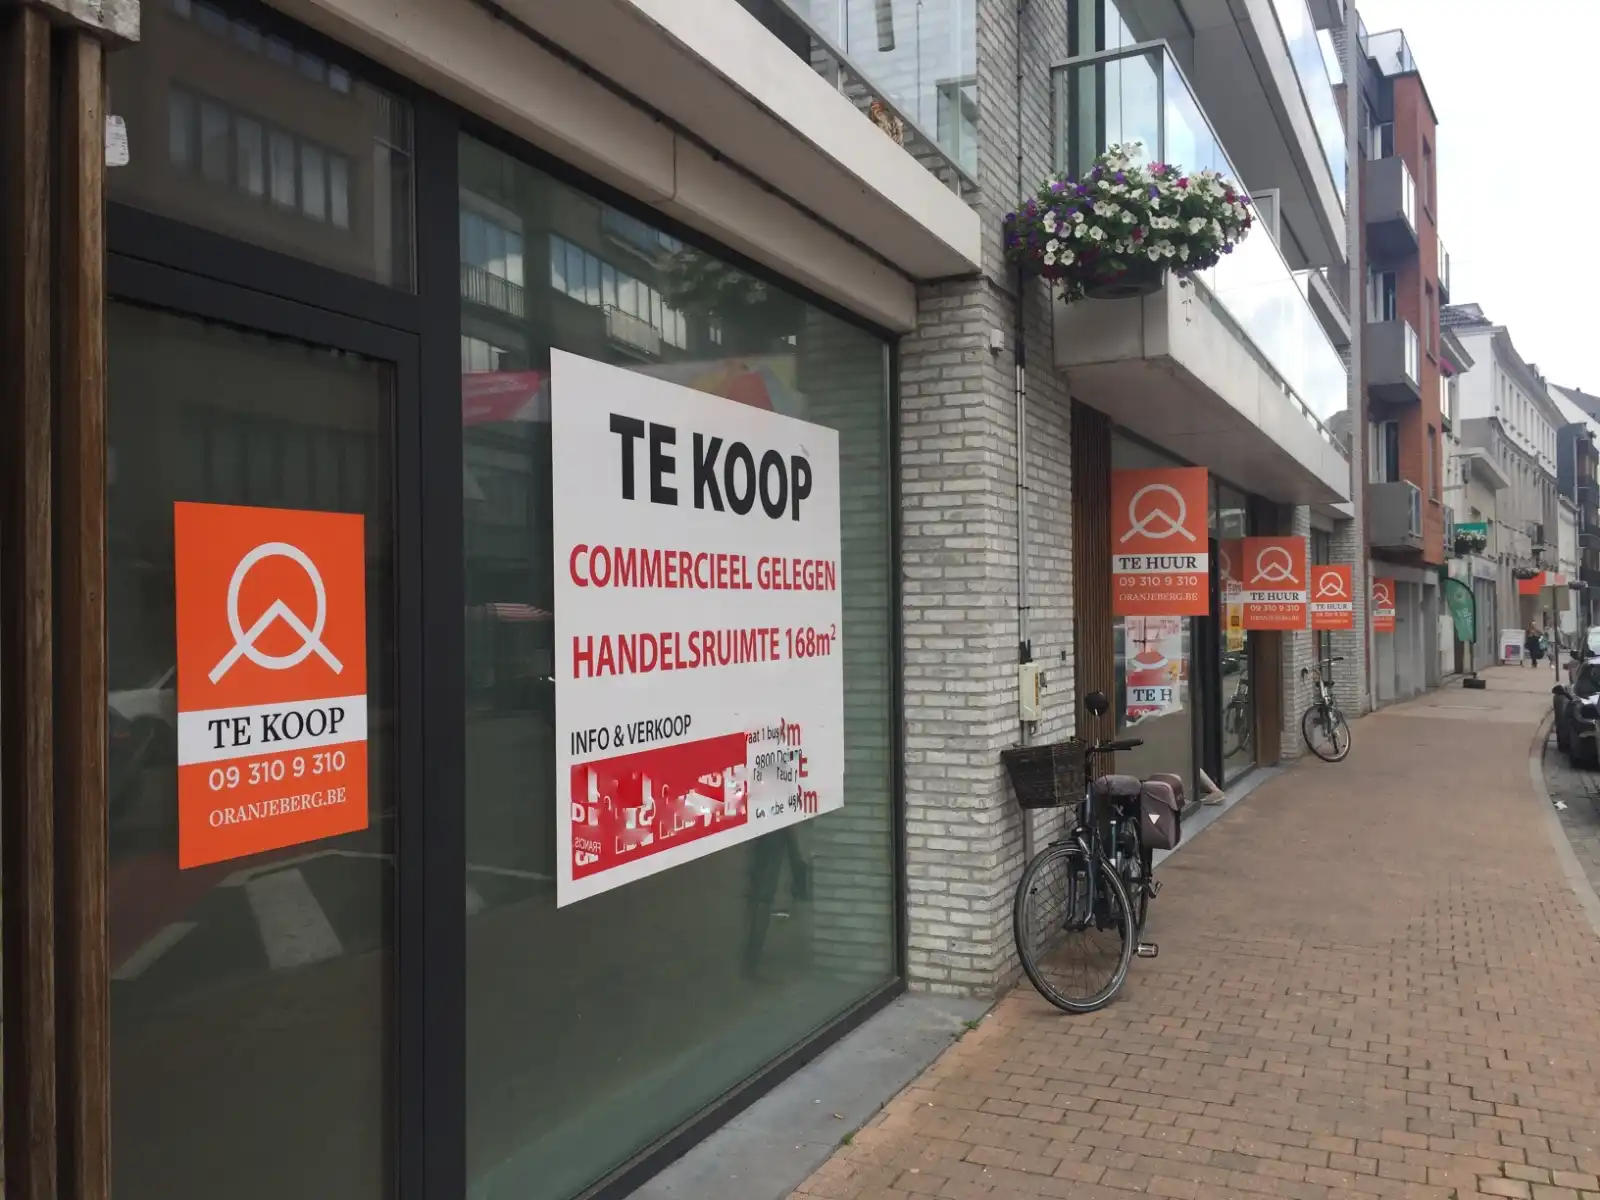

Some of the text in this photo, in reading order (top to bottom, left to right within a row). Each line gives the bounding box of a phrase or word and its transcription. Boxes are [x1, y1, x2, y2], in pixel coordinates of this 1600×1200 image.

[610, 412, 812, 521] TE KOOP
[570, 544, 836, 591] COMMERCIEEL GELEGEN
[1118, 556, 1197, 570] TE HUUR
[1119, 576, 1198, 586] 09 310 9 310
[1250, 592, 1299, 600] TE HUUR
[572, 628, 780, 679] HANDELSRUIMTE
[1132, 688, 1156, 701] TE
[208, 707, 345, 749] TE KOOP
[570, 714, 692, 755] INFO & VERKOOP
[208, 750, 346, 791] 09 310 9 310
[209, 787, 347, 828] ORANJEBERG.BE
